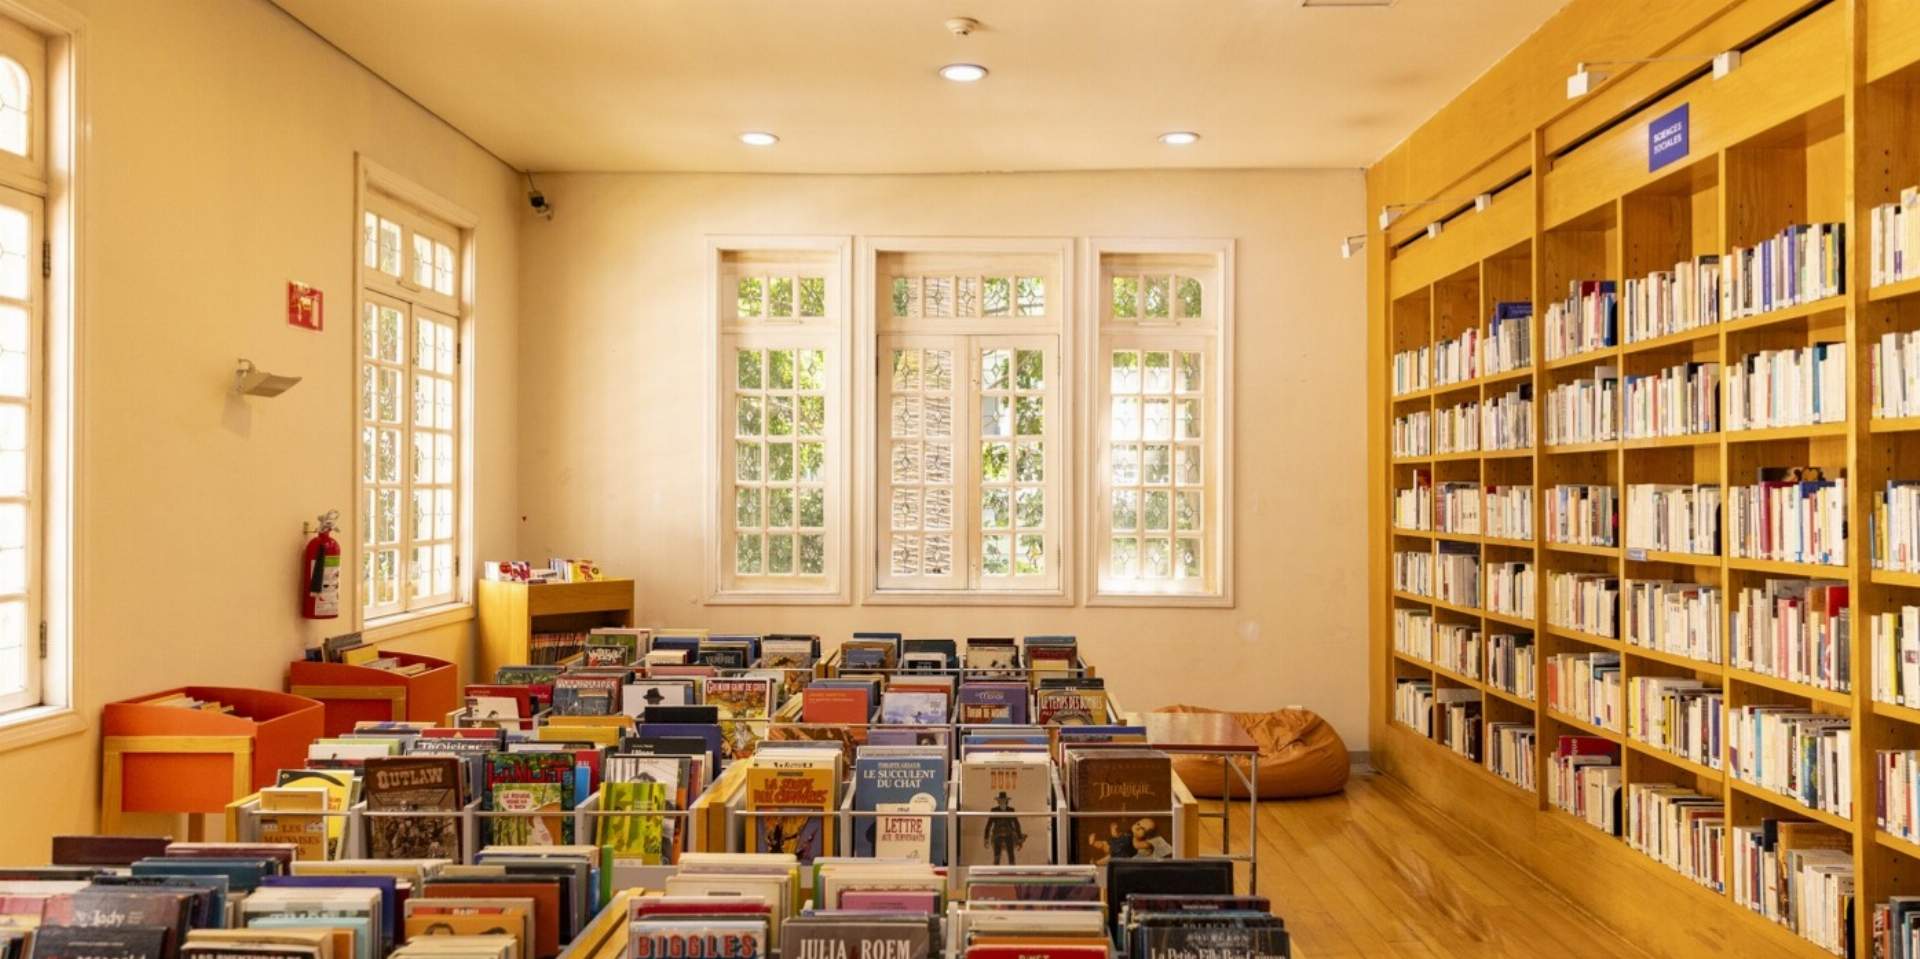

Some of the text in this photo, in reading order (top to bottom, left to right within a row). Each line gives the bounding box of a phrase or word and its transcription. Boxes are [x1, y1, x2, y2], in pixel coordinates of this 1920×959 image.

[1653, 121, 1682, 144] SCIENCES
[1653, 133, 1682, 155] SOCIALES
[376, 767, 444, 789] OUTLAW
[864, 769, 936, 779] LE SUCCULENT
[877, 779, 921, 788] DU CHAT
[282, 824, 302, 833] LES
[885, 817, 923, 833] LETTRE
[639, 935, 758, 959] BIGGLES
[796, 939, 847, 959] JULIA
[861, 939, 911, 959] ROEM
